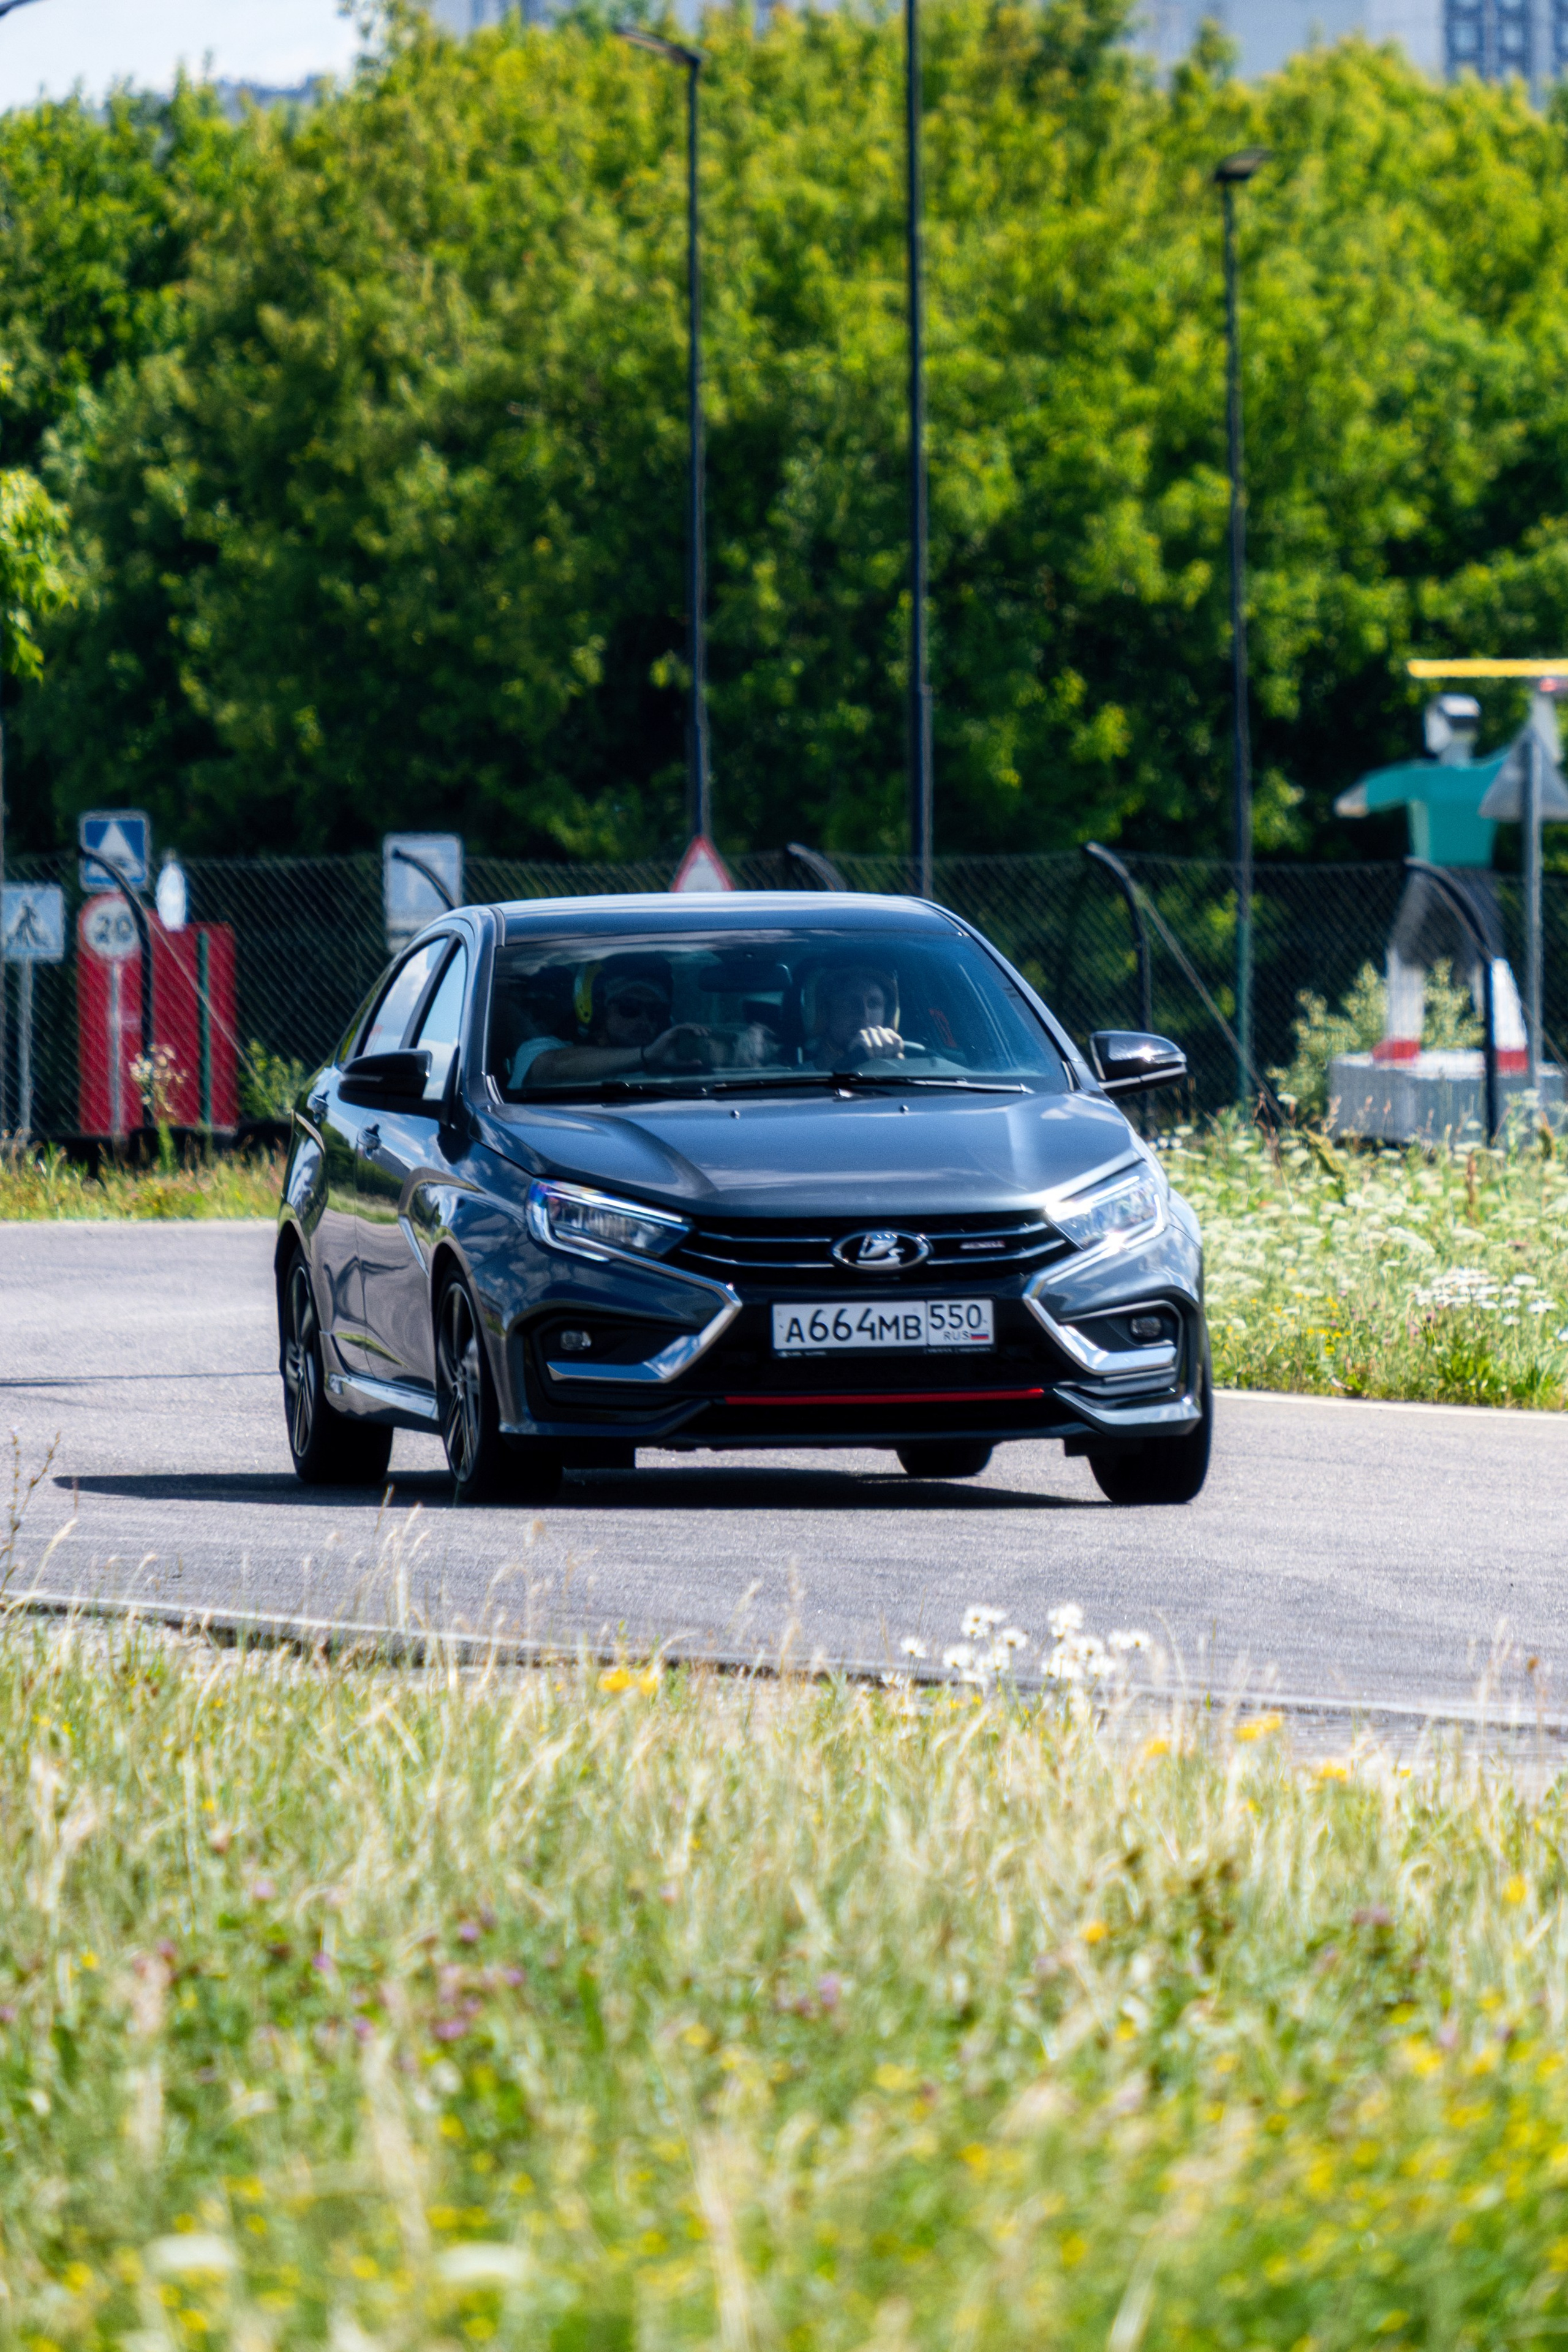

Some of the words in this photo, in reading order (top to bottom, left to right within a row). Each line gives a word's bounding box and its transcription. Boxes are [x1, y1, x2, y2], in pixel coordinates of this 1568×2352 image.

[96, 913, 133, 943] 20
[785, 1307, 922, 1343] А664МВ
[929, 1304, 982, 1330] 550
[943, 1330, 970, 1341] RUS
